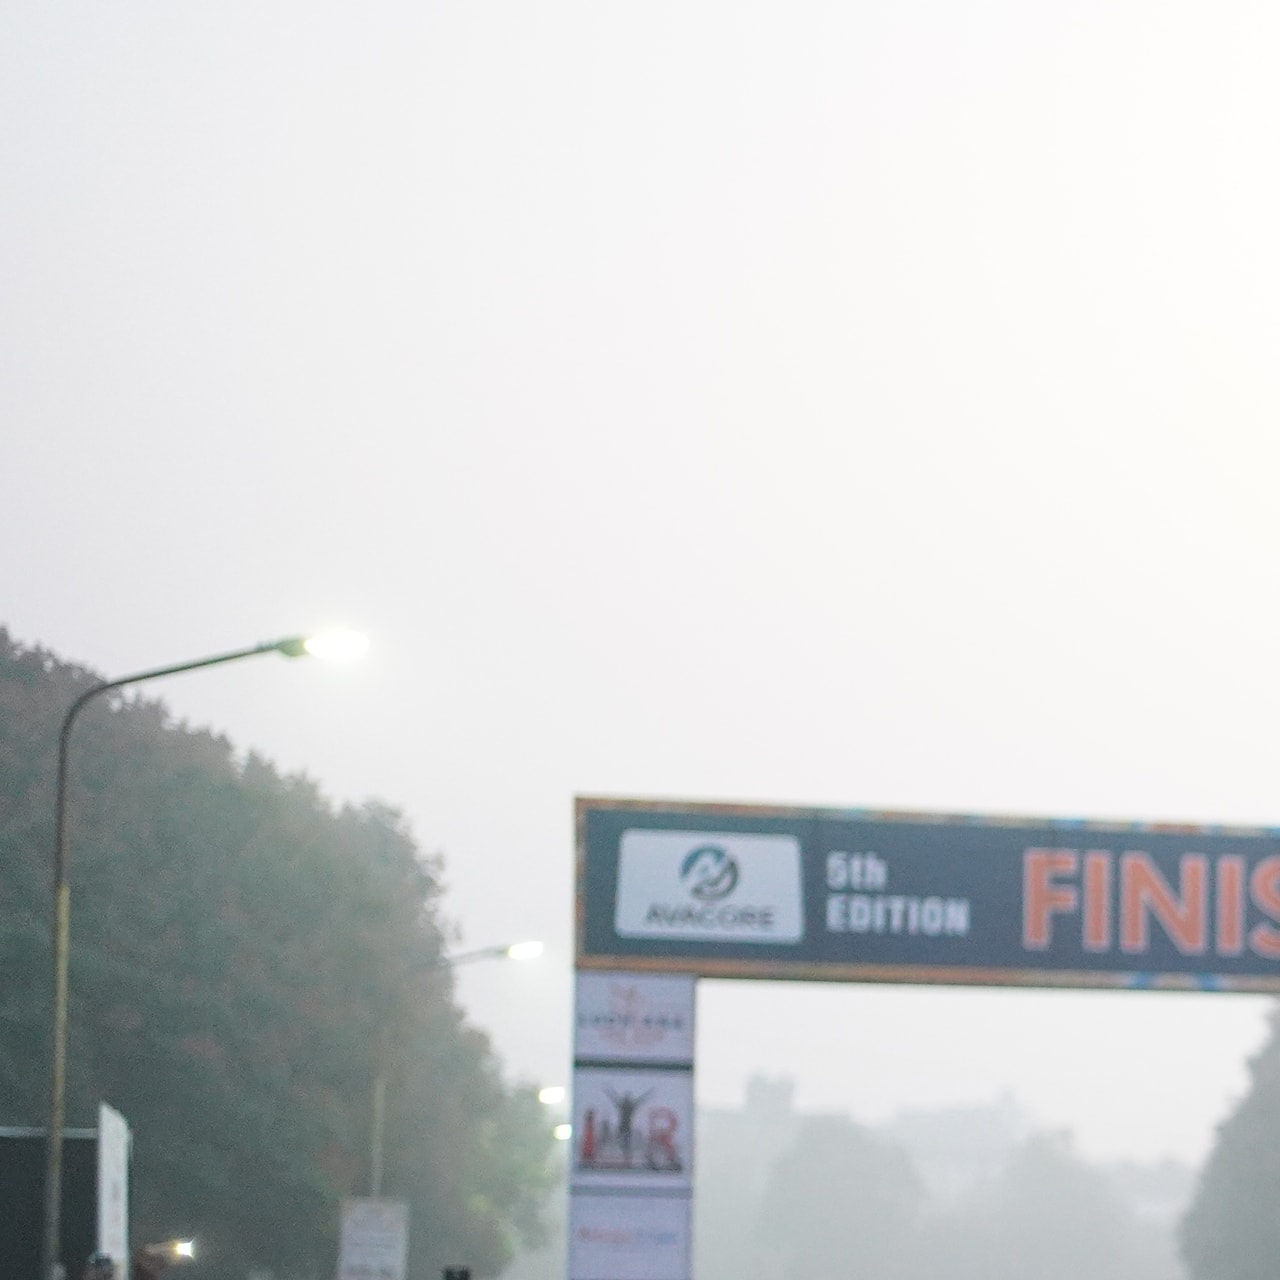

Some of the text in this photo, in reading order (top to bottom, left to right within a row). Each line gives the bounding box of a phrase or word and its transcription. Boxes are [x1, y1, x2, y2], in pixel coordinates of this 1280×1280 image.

[826, 850, 888, 889] 5th
[646, 902, 774, 931] AVACORE
[826, 895, 970, 937] EDITION
